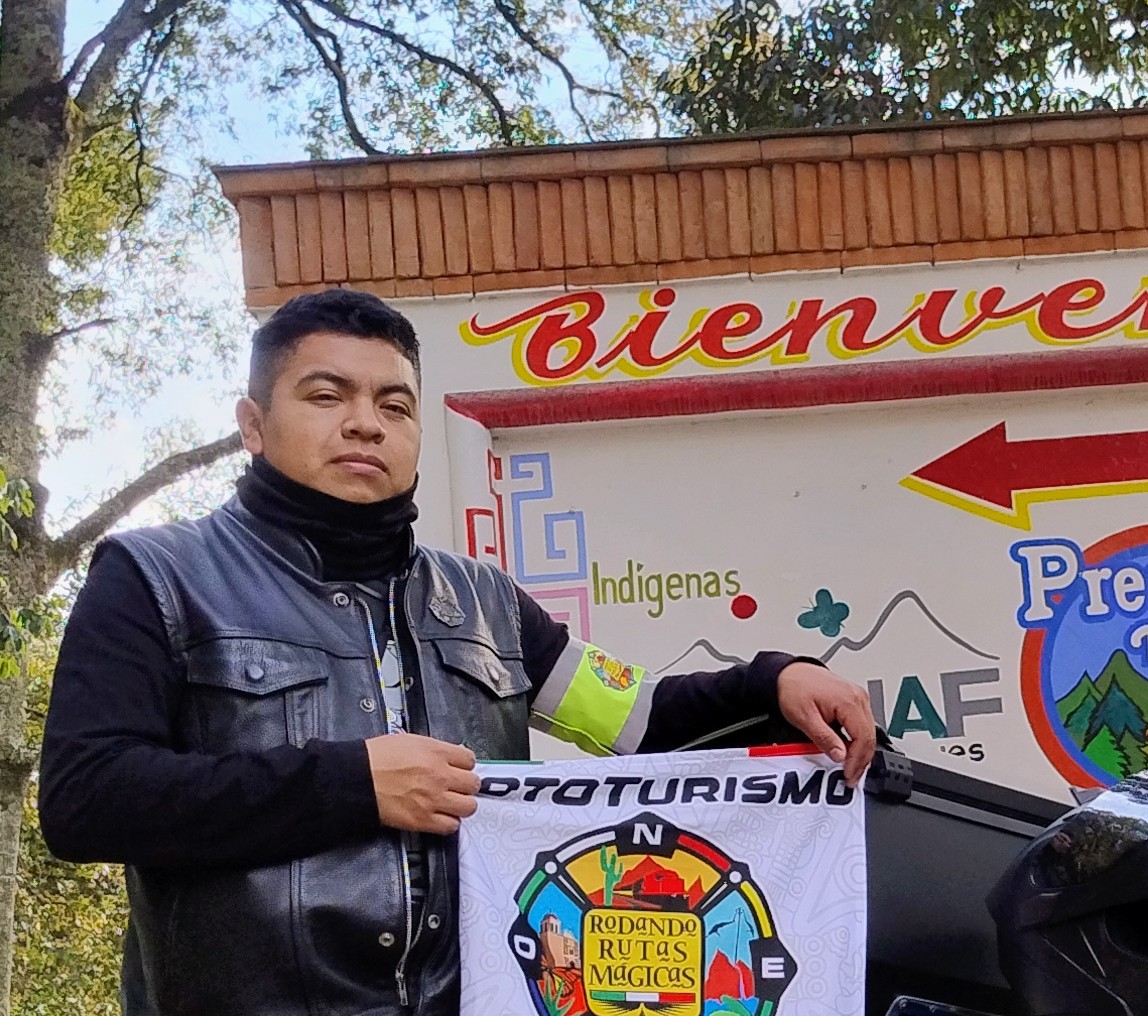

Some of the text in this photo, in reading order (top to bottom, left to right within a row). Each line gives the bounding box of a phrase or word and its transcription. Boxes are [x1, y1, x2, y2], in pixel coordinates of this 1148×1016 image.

[592, 559, 741, 618] Indígenas
[479, 769, 856, 806] OTOTURISMO
[632, 823, 662, 845] N
[513, 935, 537, 961] O
[761, 957, 785, 979] E
